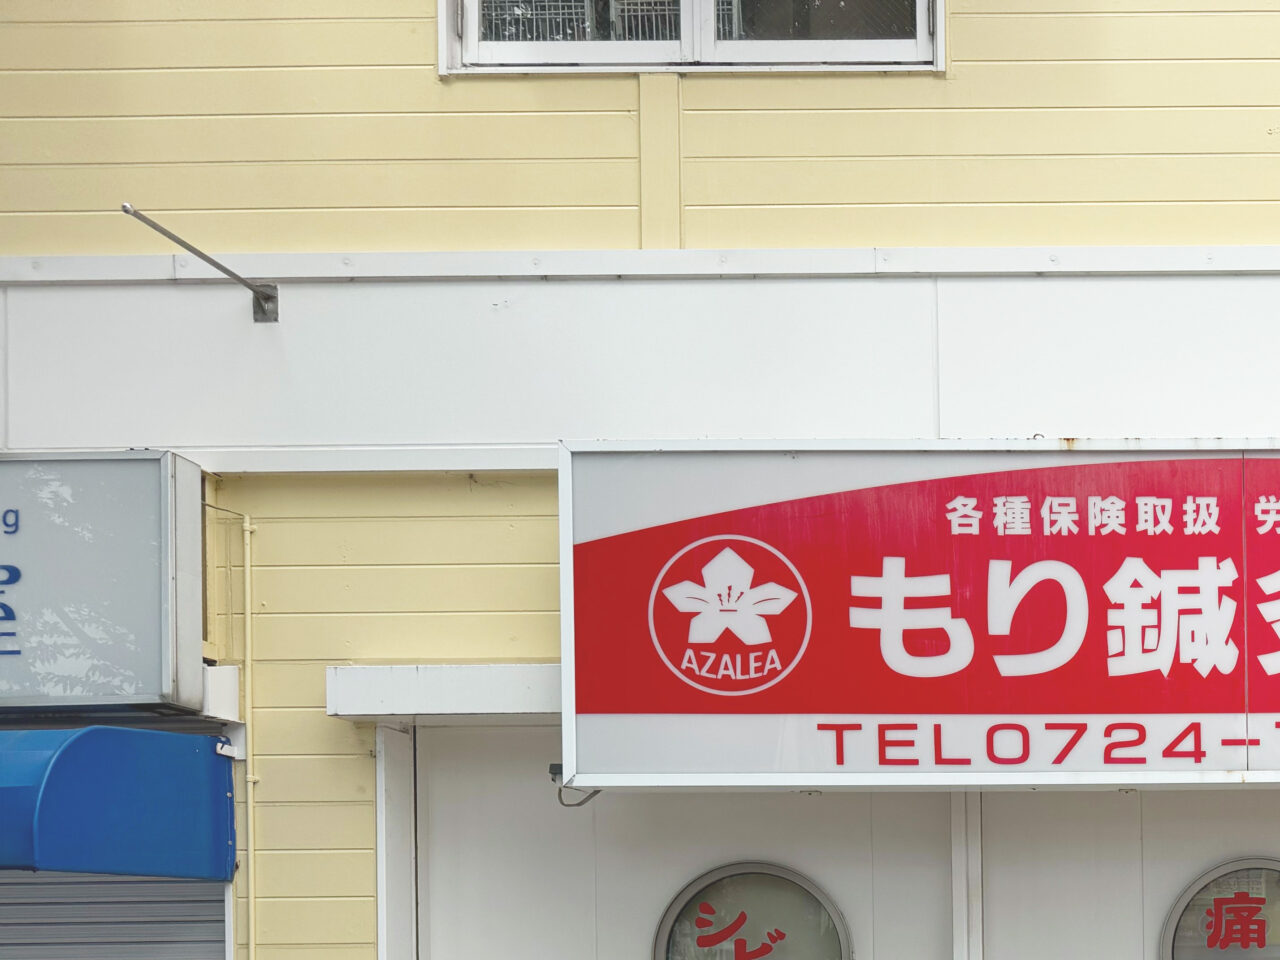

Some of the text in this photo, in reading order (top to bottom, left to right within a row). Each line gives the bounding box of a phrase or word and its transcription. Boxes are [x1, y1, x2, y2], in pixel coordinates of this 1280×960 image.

[946, 495, 1220, 537] 各種保険取扱
[681, 648, 782, 680] AZALEA
